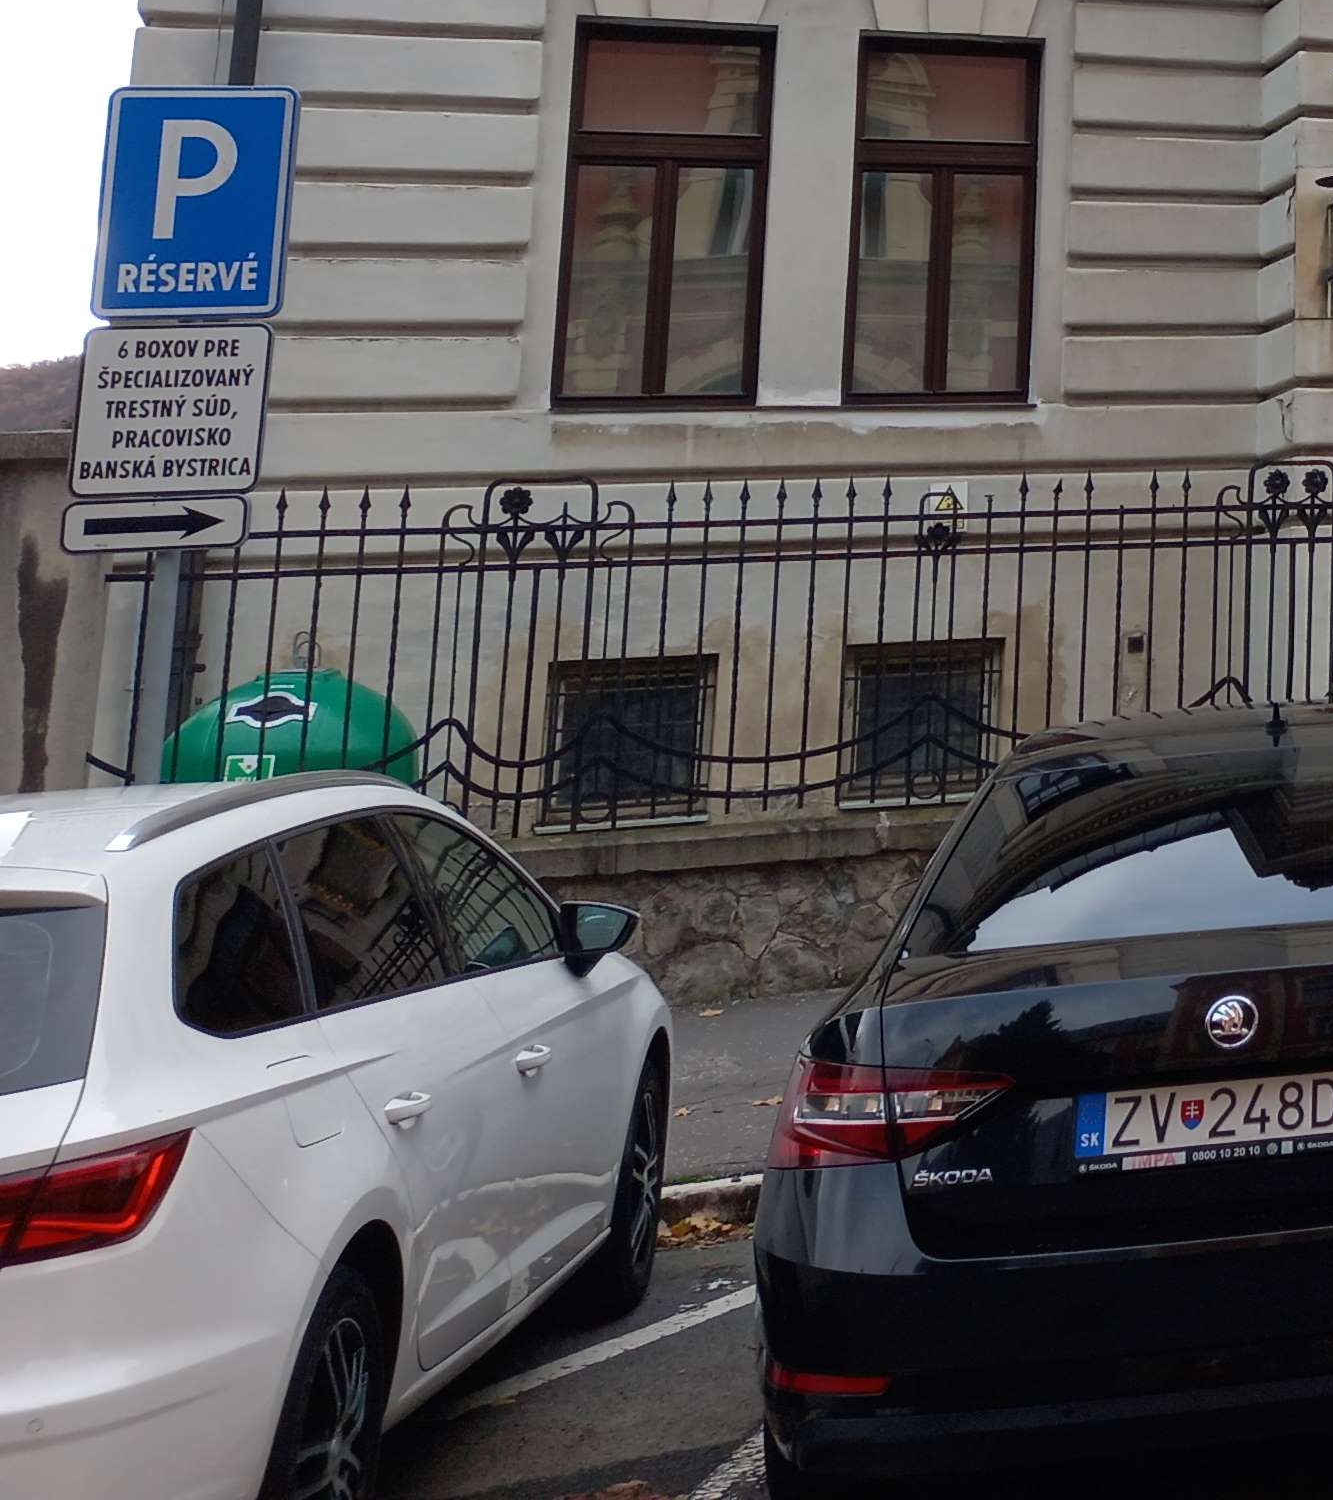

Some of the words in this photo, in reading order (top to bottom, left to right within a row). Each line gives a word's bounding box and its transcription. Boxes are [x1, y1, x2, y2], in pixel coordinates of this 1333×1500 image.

[153, 118, 238, 240] P
[117, 252, 259, 293] RÉSERVÉ
[118, 340, 129, 359] 6
[135, 339, 199, 359] BOXOV
[204, 338, 240, 358] PRE
[97, 364, 256, 389] ŠPECIALIZOVANÝ
[105, 395, 187, 419] TRESTNÝ
[192, 394, 238, 420] SÚD,
[111, 427, 232, 449] PRACOVISKO
[79, 455, 156, 480] BANSKÁ
[162, 457, 251, 479] BYSTRICA
[1080, 1131, 1100, 1148] SK
[1192, 1149, 1217, 1161] 0800
[1220, 1148, 1231, 1159] 10
[1233, 1147, 1246, 1157] 20
[1249, 1145, 1261, 1156] 10
[913, 1167, 993, 1187] ŠKODA
